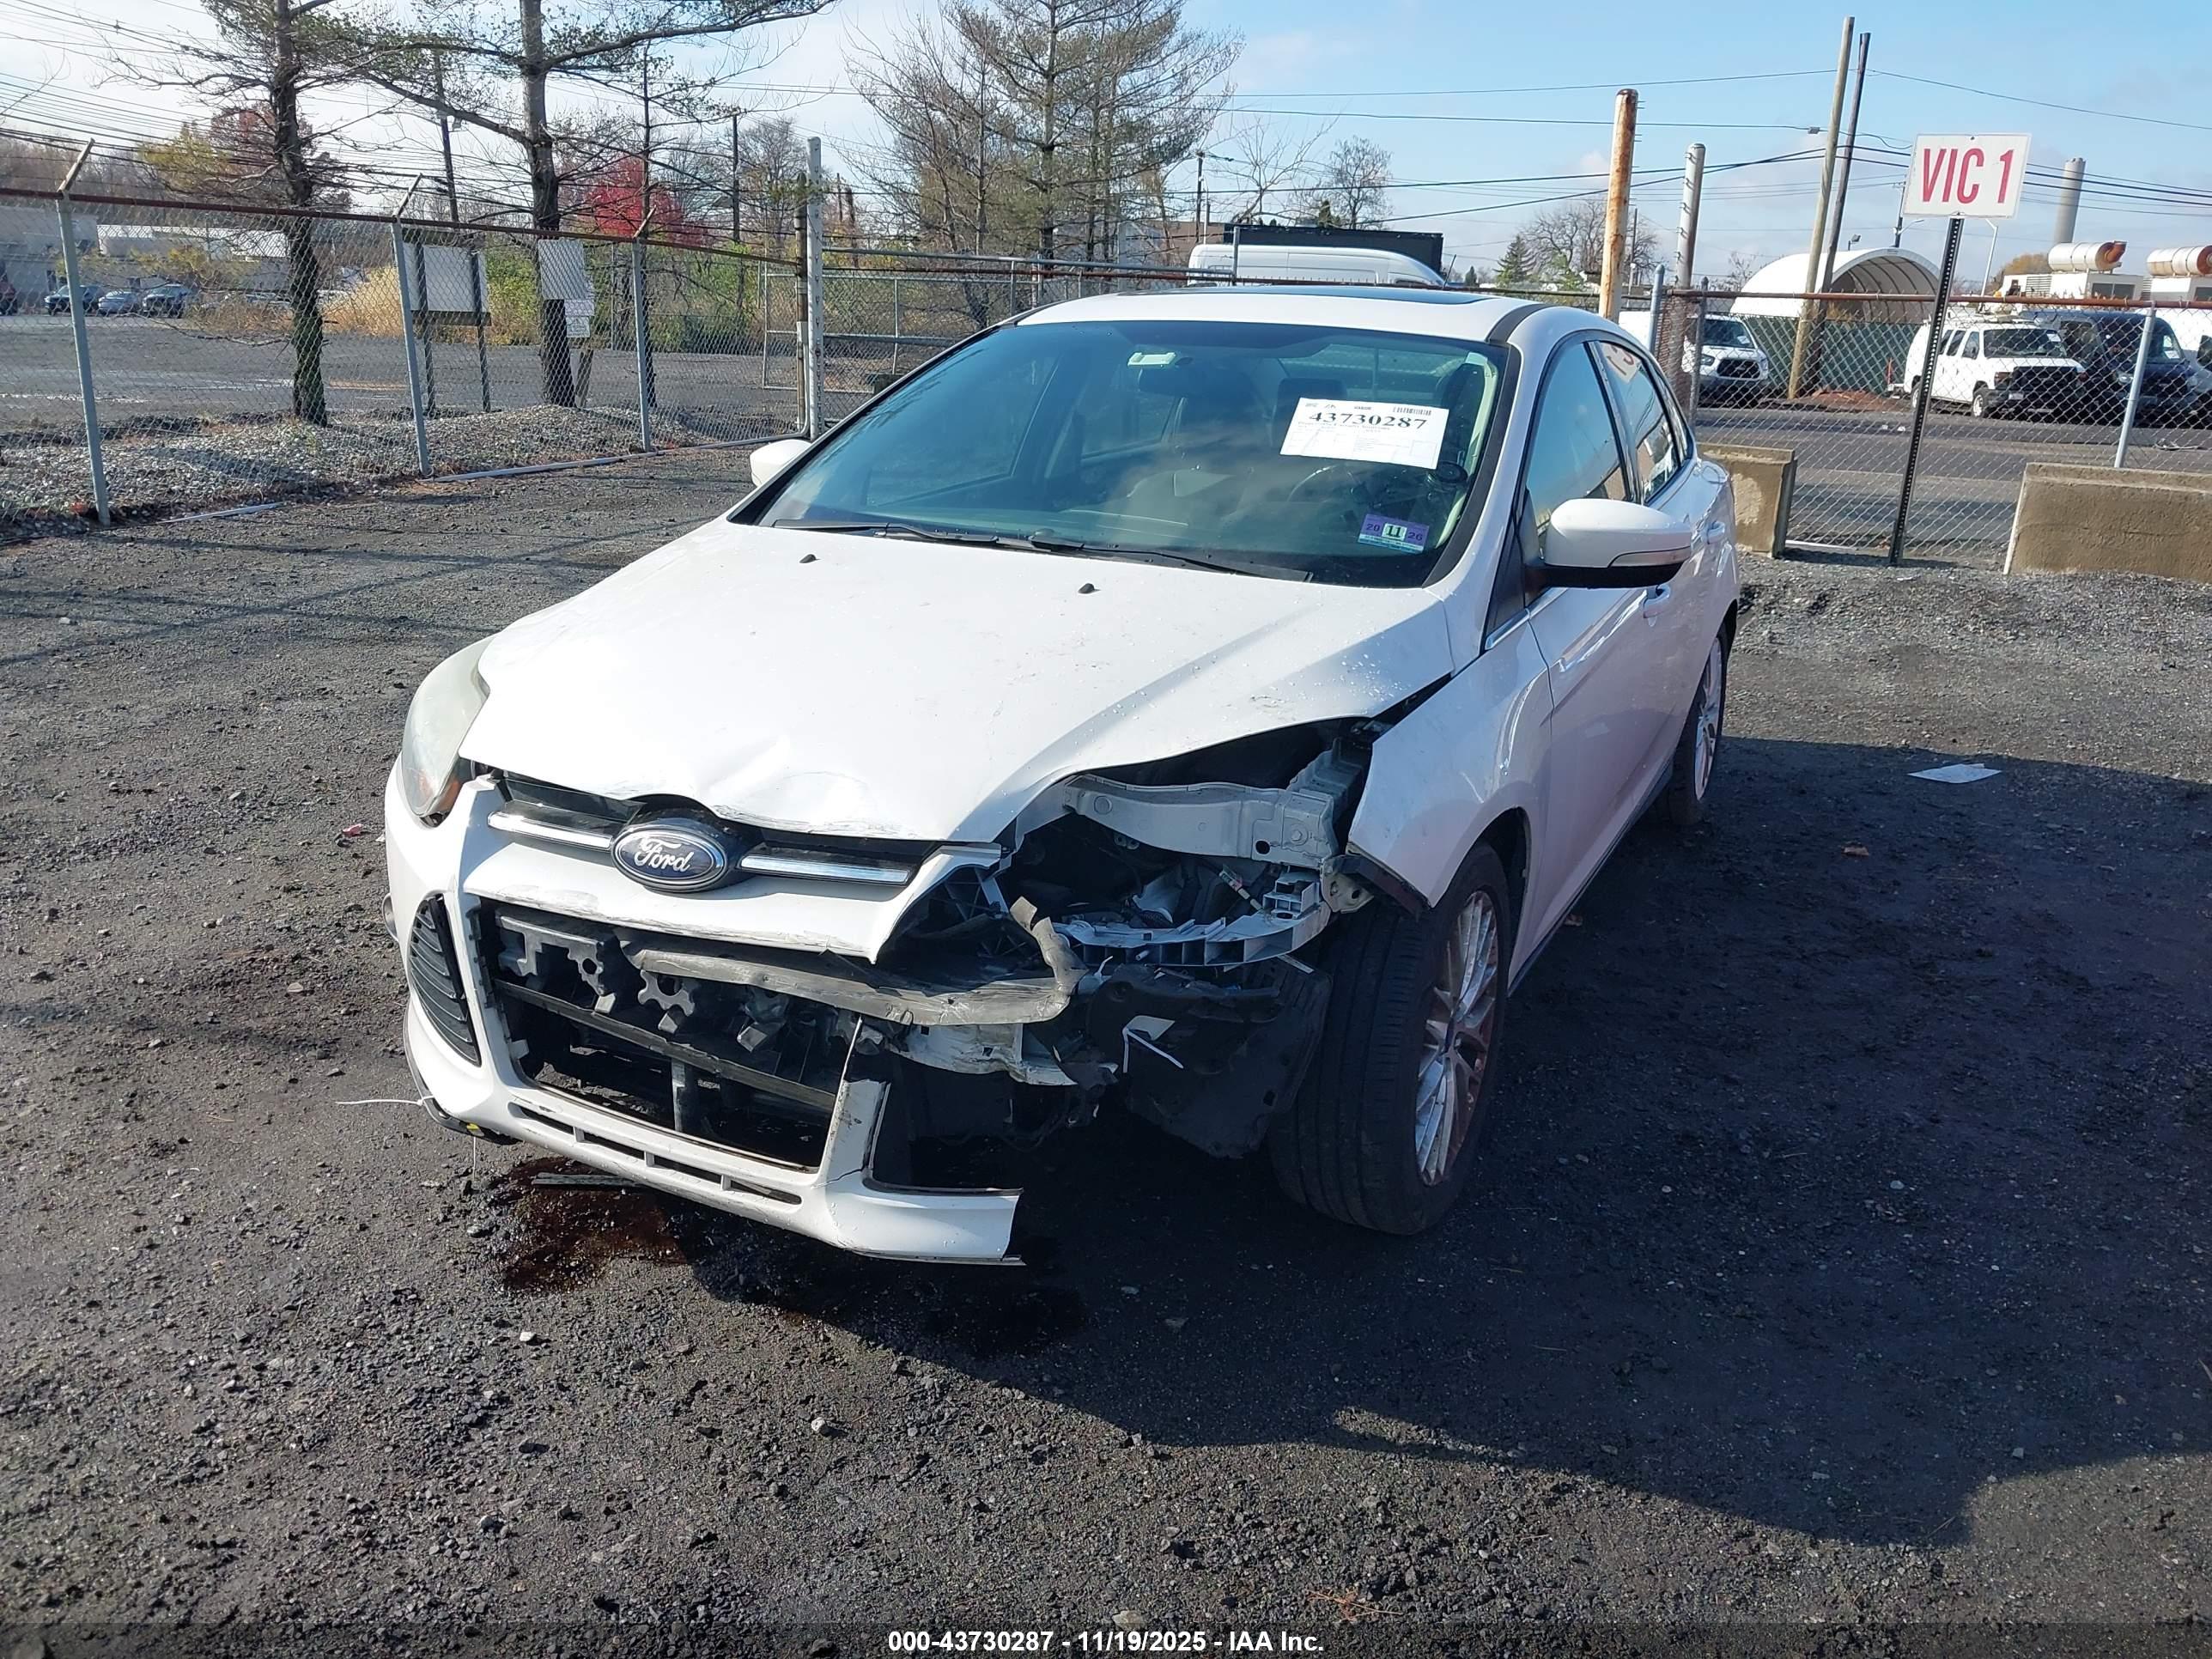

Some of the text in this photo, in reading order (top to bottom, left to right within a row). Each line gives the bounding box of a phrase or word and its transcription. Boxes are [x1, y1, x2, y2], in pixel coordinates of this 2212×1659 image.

[1922, 148, 2014, 204] VIC 1
[1309, 411, 1427, 429] 43730287
[1386, 525, 1401, 538] 11
[634, 838, 695, 872] Ford
